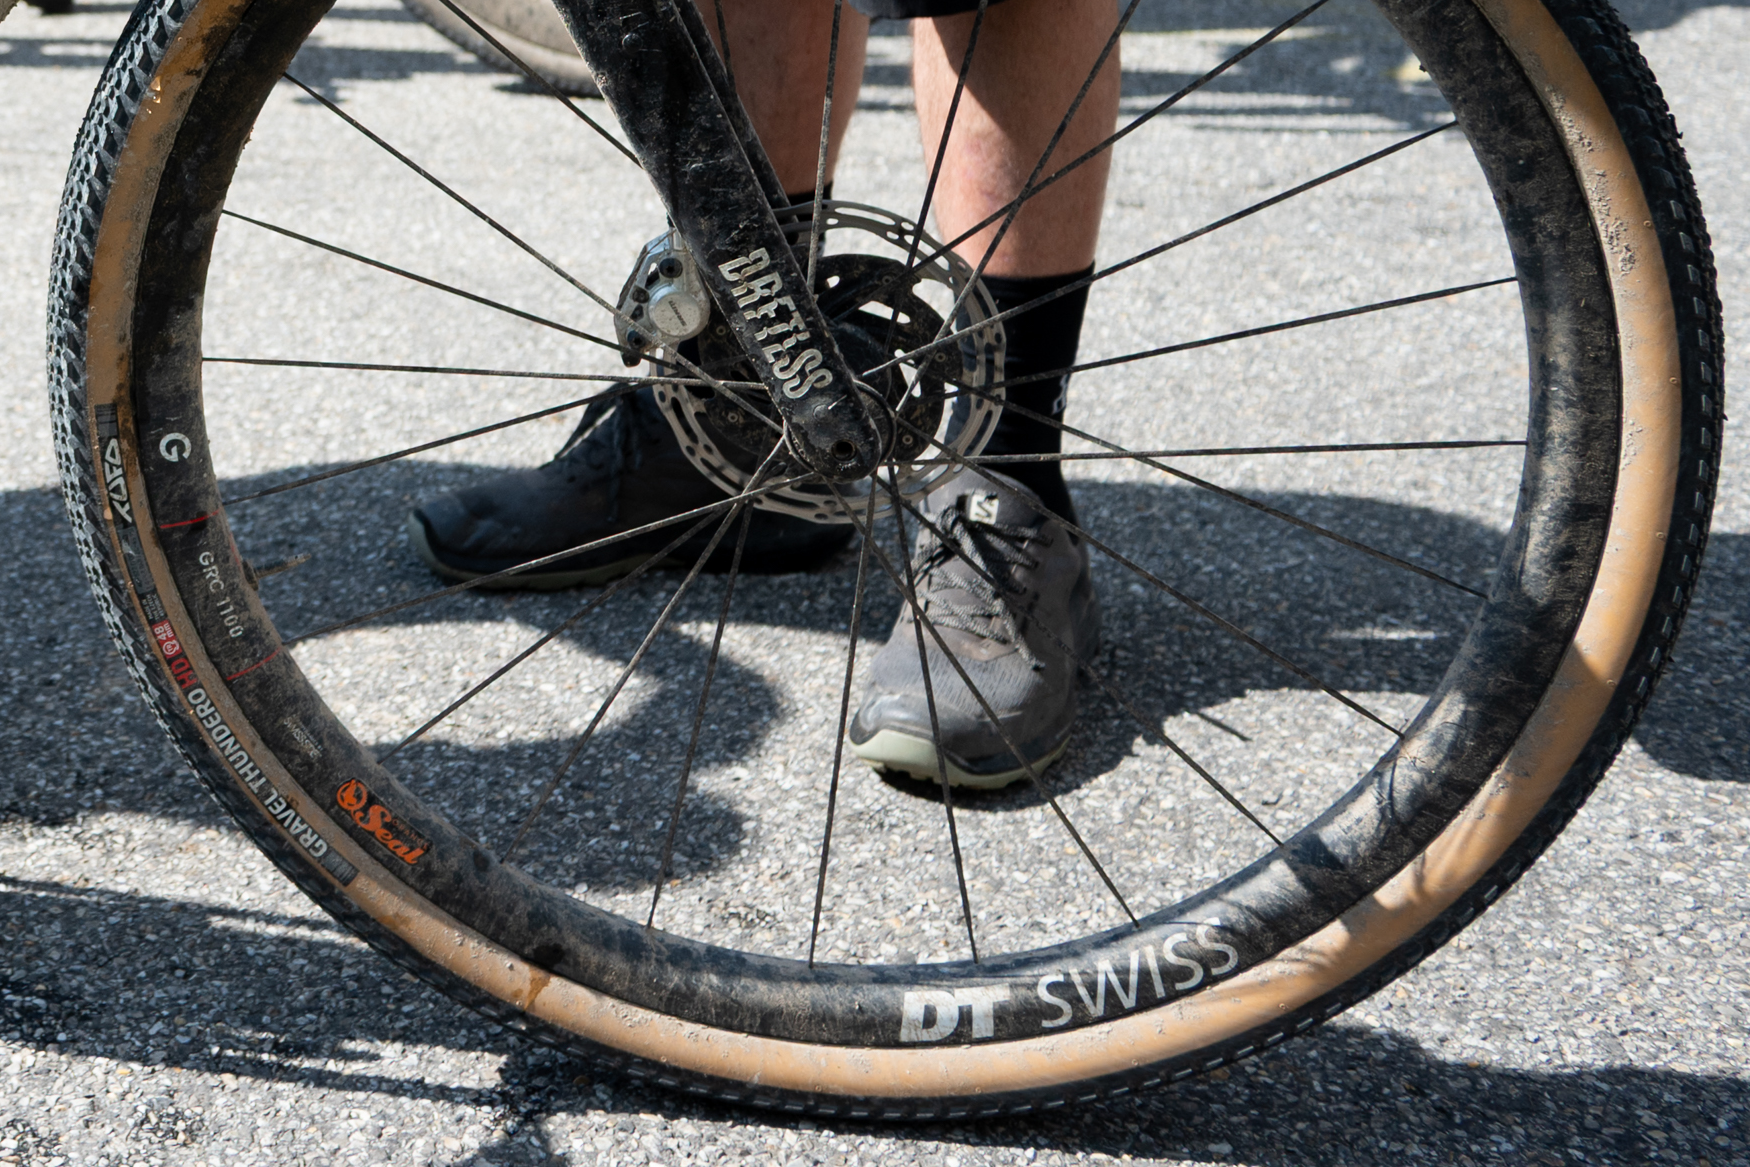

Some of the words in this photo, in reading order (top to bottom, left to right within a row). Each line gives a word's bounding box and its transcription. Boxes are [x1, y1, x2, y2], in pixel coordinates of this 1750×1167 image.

[104, 437, 133, 524] TUFO
[159, 432, 192, 462] G
[199, 551, 225, 593] GRC
[216, 596, 245, 639] 1100
[154, 625, 168, 641] 48
[164, 622, 174, 638] mm
[171, 656, 199, 690] HD
[187, 688, 267, 795] THUNDERO
[263, 785, 329, 859] GRAVEL
[351, 804, 426, 865] Seal
[901, 984, 1011, 1043] DT
[1036, 917, 1240, 1029] SWISS
